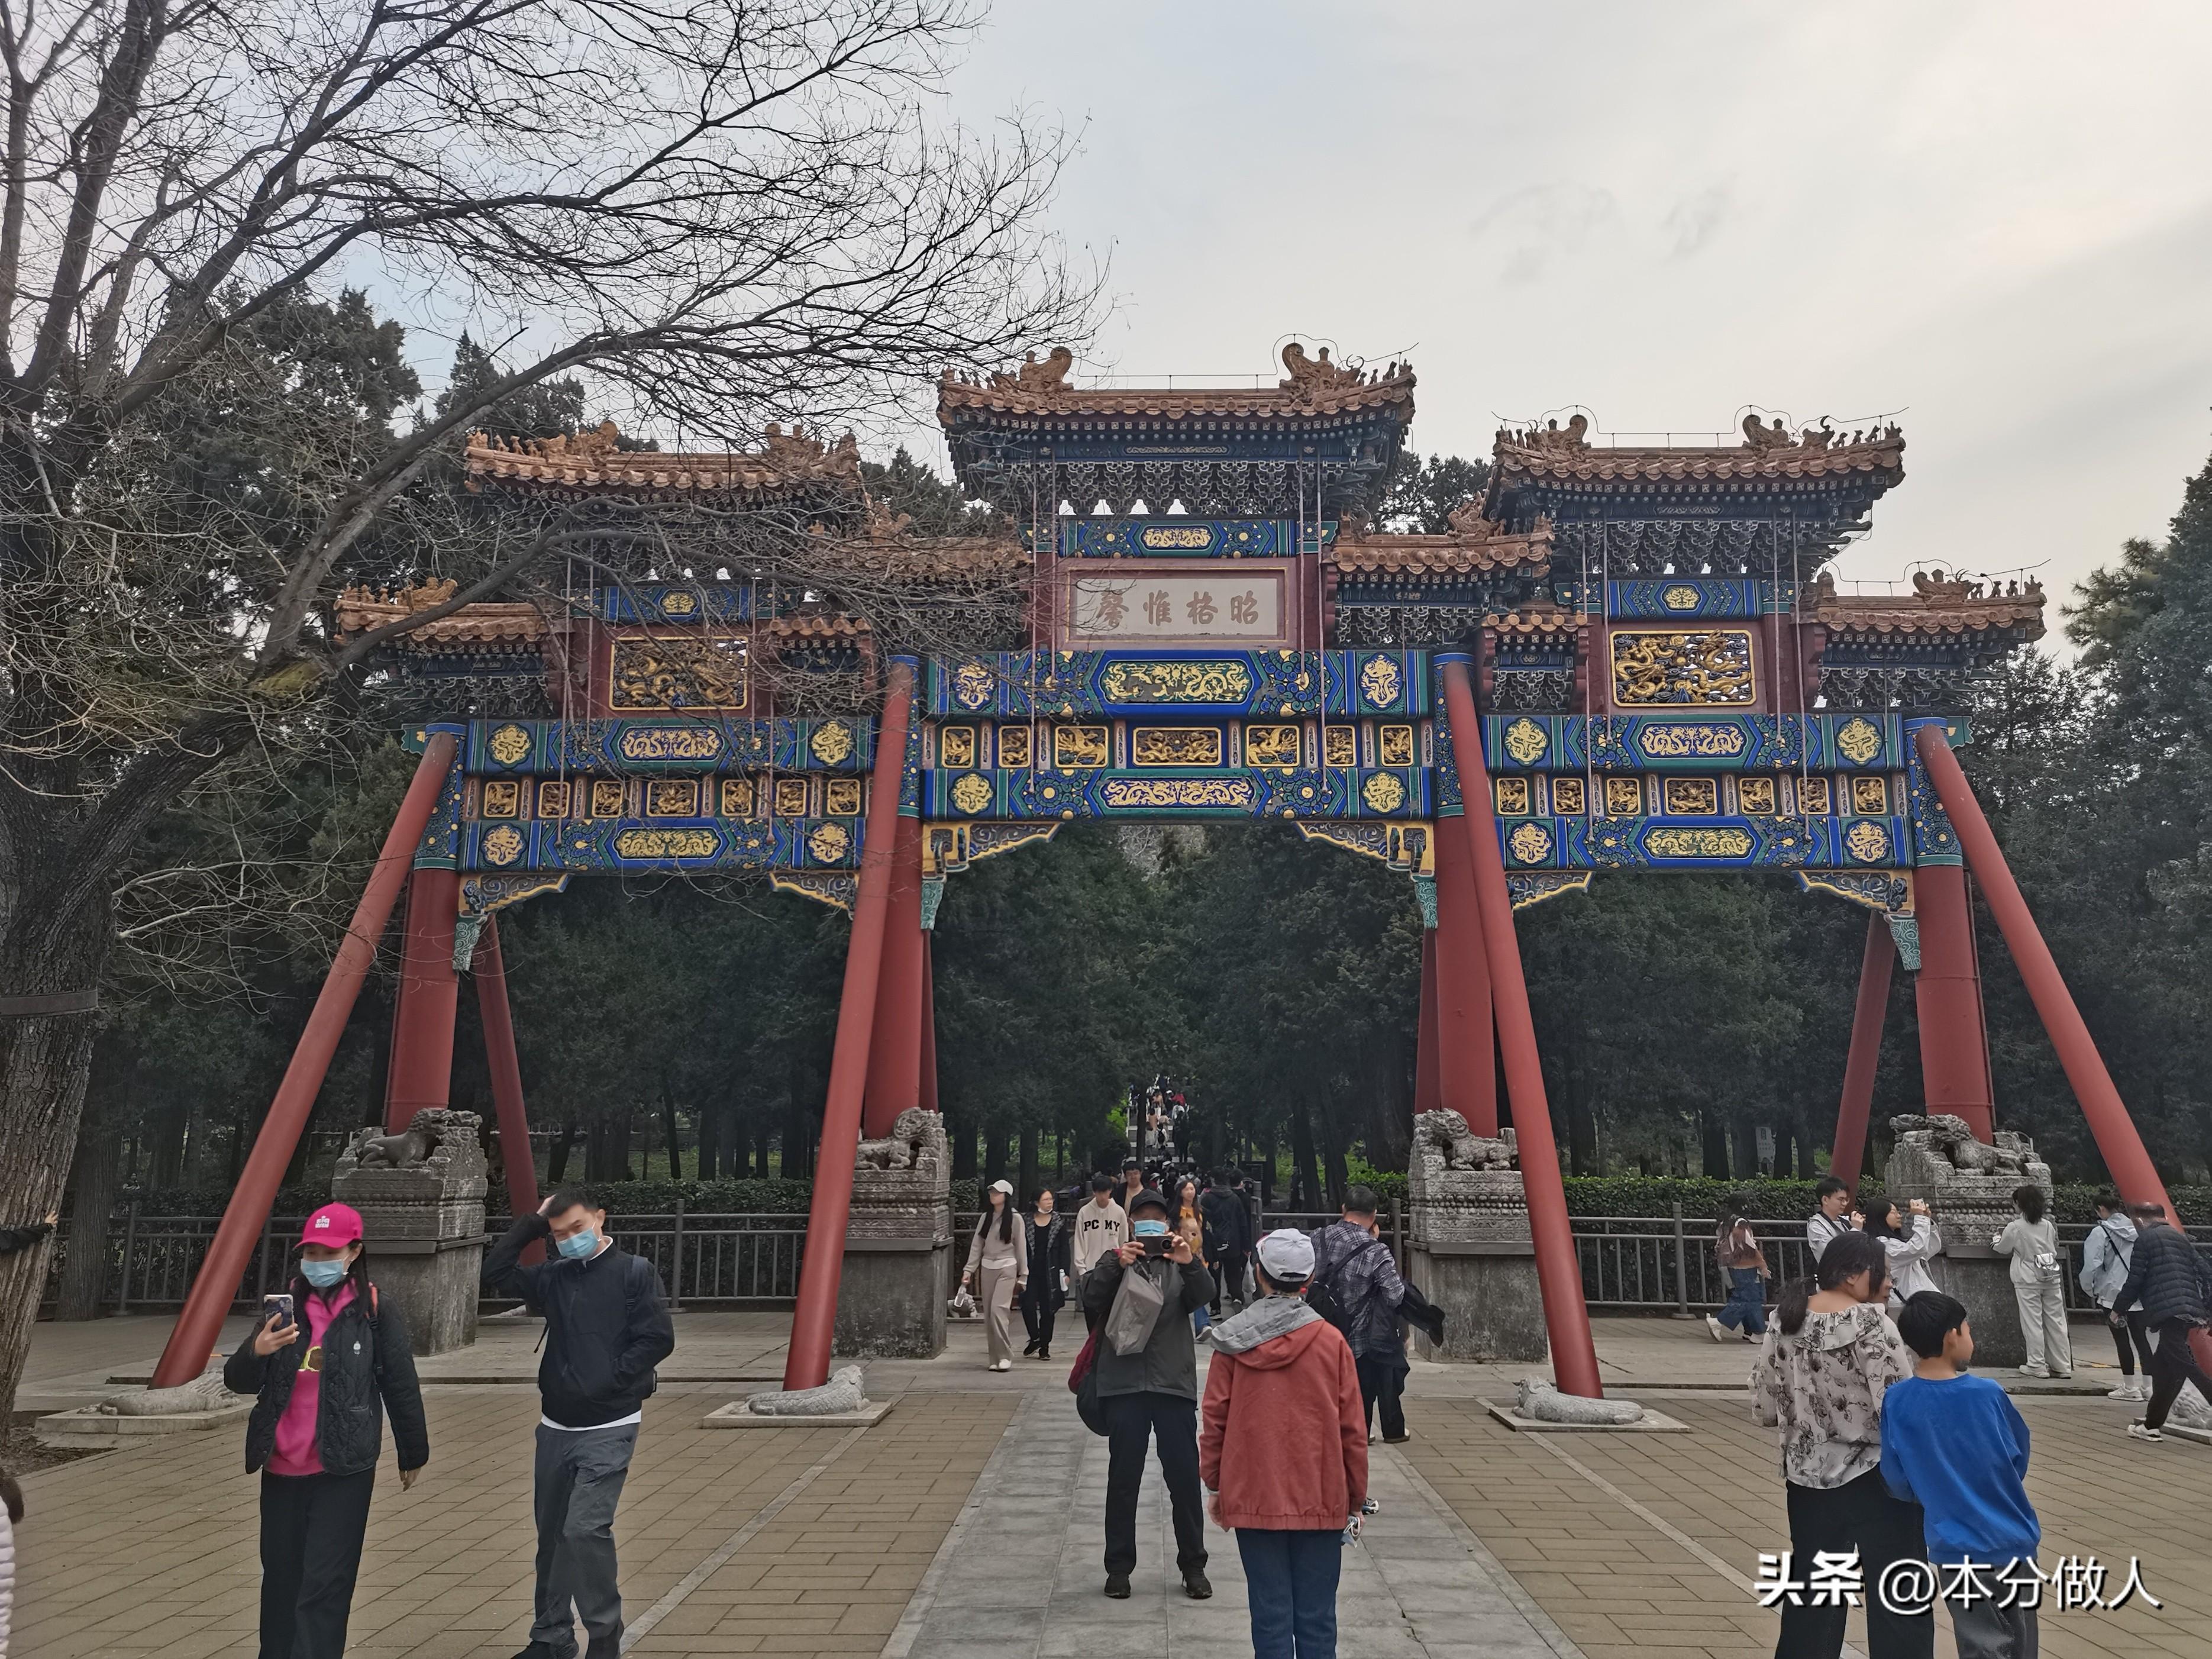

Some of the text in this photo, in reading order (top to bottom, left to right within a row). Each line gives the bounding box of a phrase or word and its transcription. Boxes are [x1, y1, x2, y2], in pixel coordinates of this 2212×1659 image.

[1096, 588, 1260, 628] 昭格惟馨
[1084, 1219, 1120, 1231] PC MY
